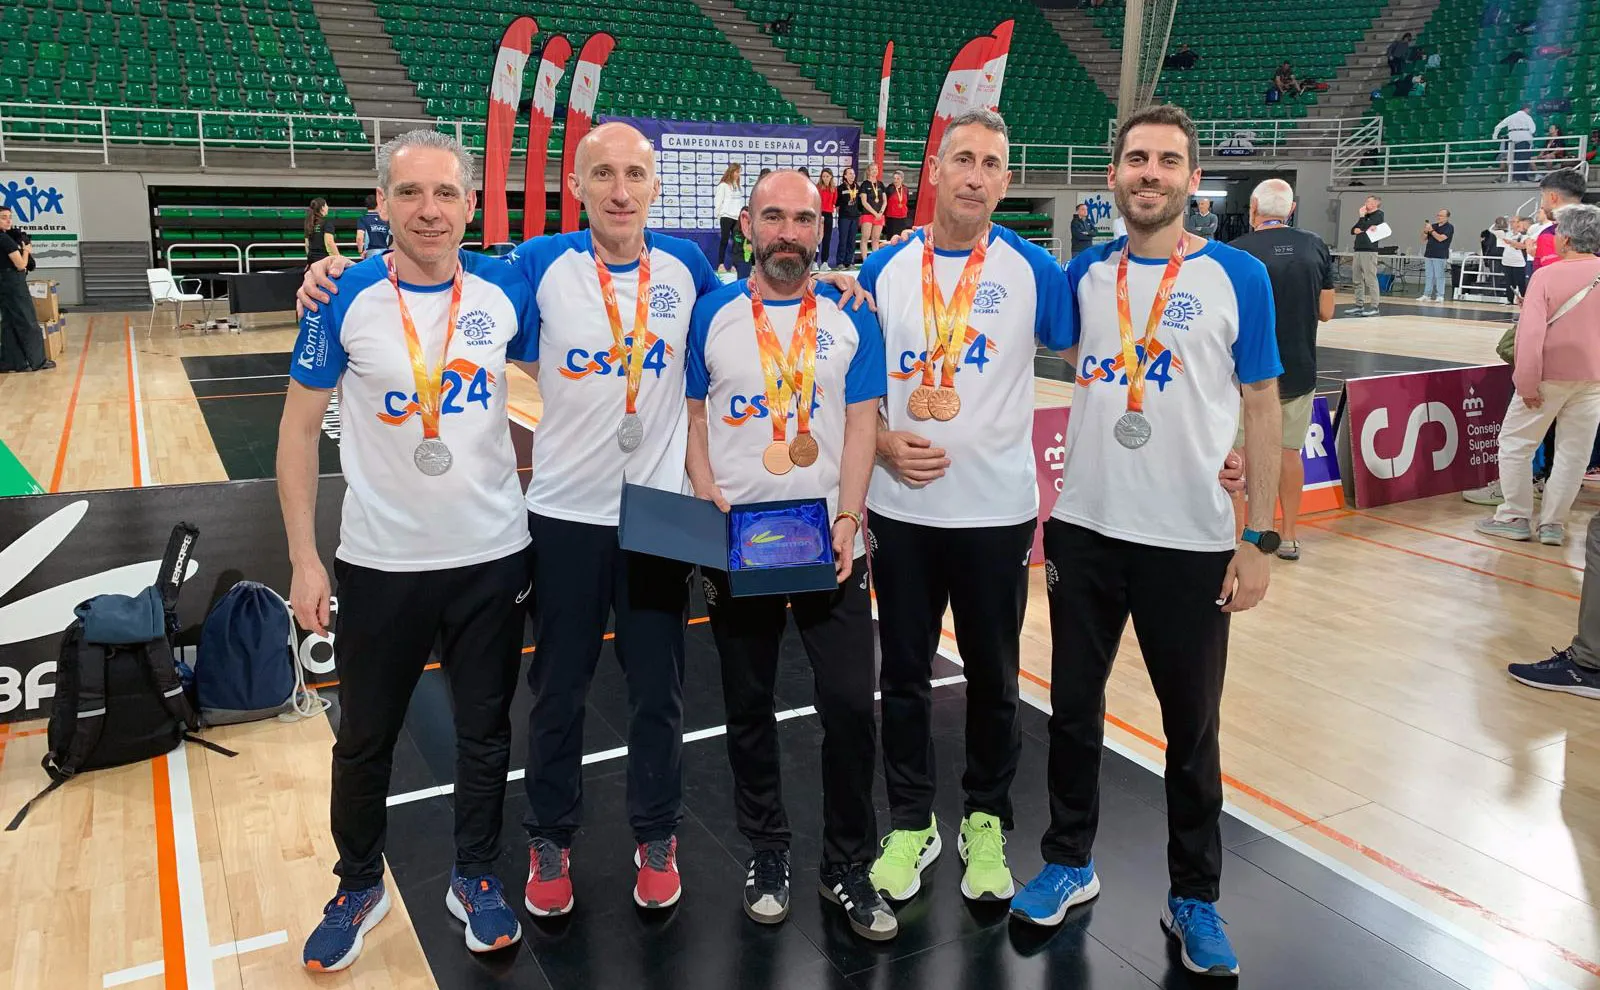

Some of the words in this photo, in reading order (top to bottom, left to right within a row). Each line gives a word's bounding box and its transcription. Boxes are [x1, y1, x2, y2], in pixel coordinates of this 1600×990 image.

[668, 137, 744, 148] CAMPEONATOS
[748, 140, 763, 149] DE
[764, 140, 801, 150] ESPAÑA
[455, 310, 496, 330] BADMINTON
[1162, 320, 1190, 332] SORIA
[1467, 420, 1501, 436] Consejo
[1469, 435, 1500, 452] Superio
[1470, 453, 1481, 466] de
[1482, 452, 1500, 465] Dep
